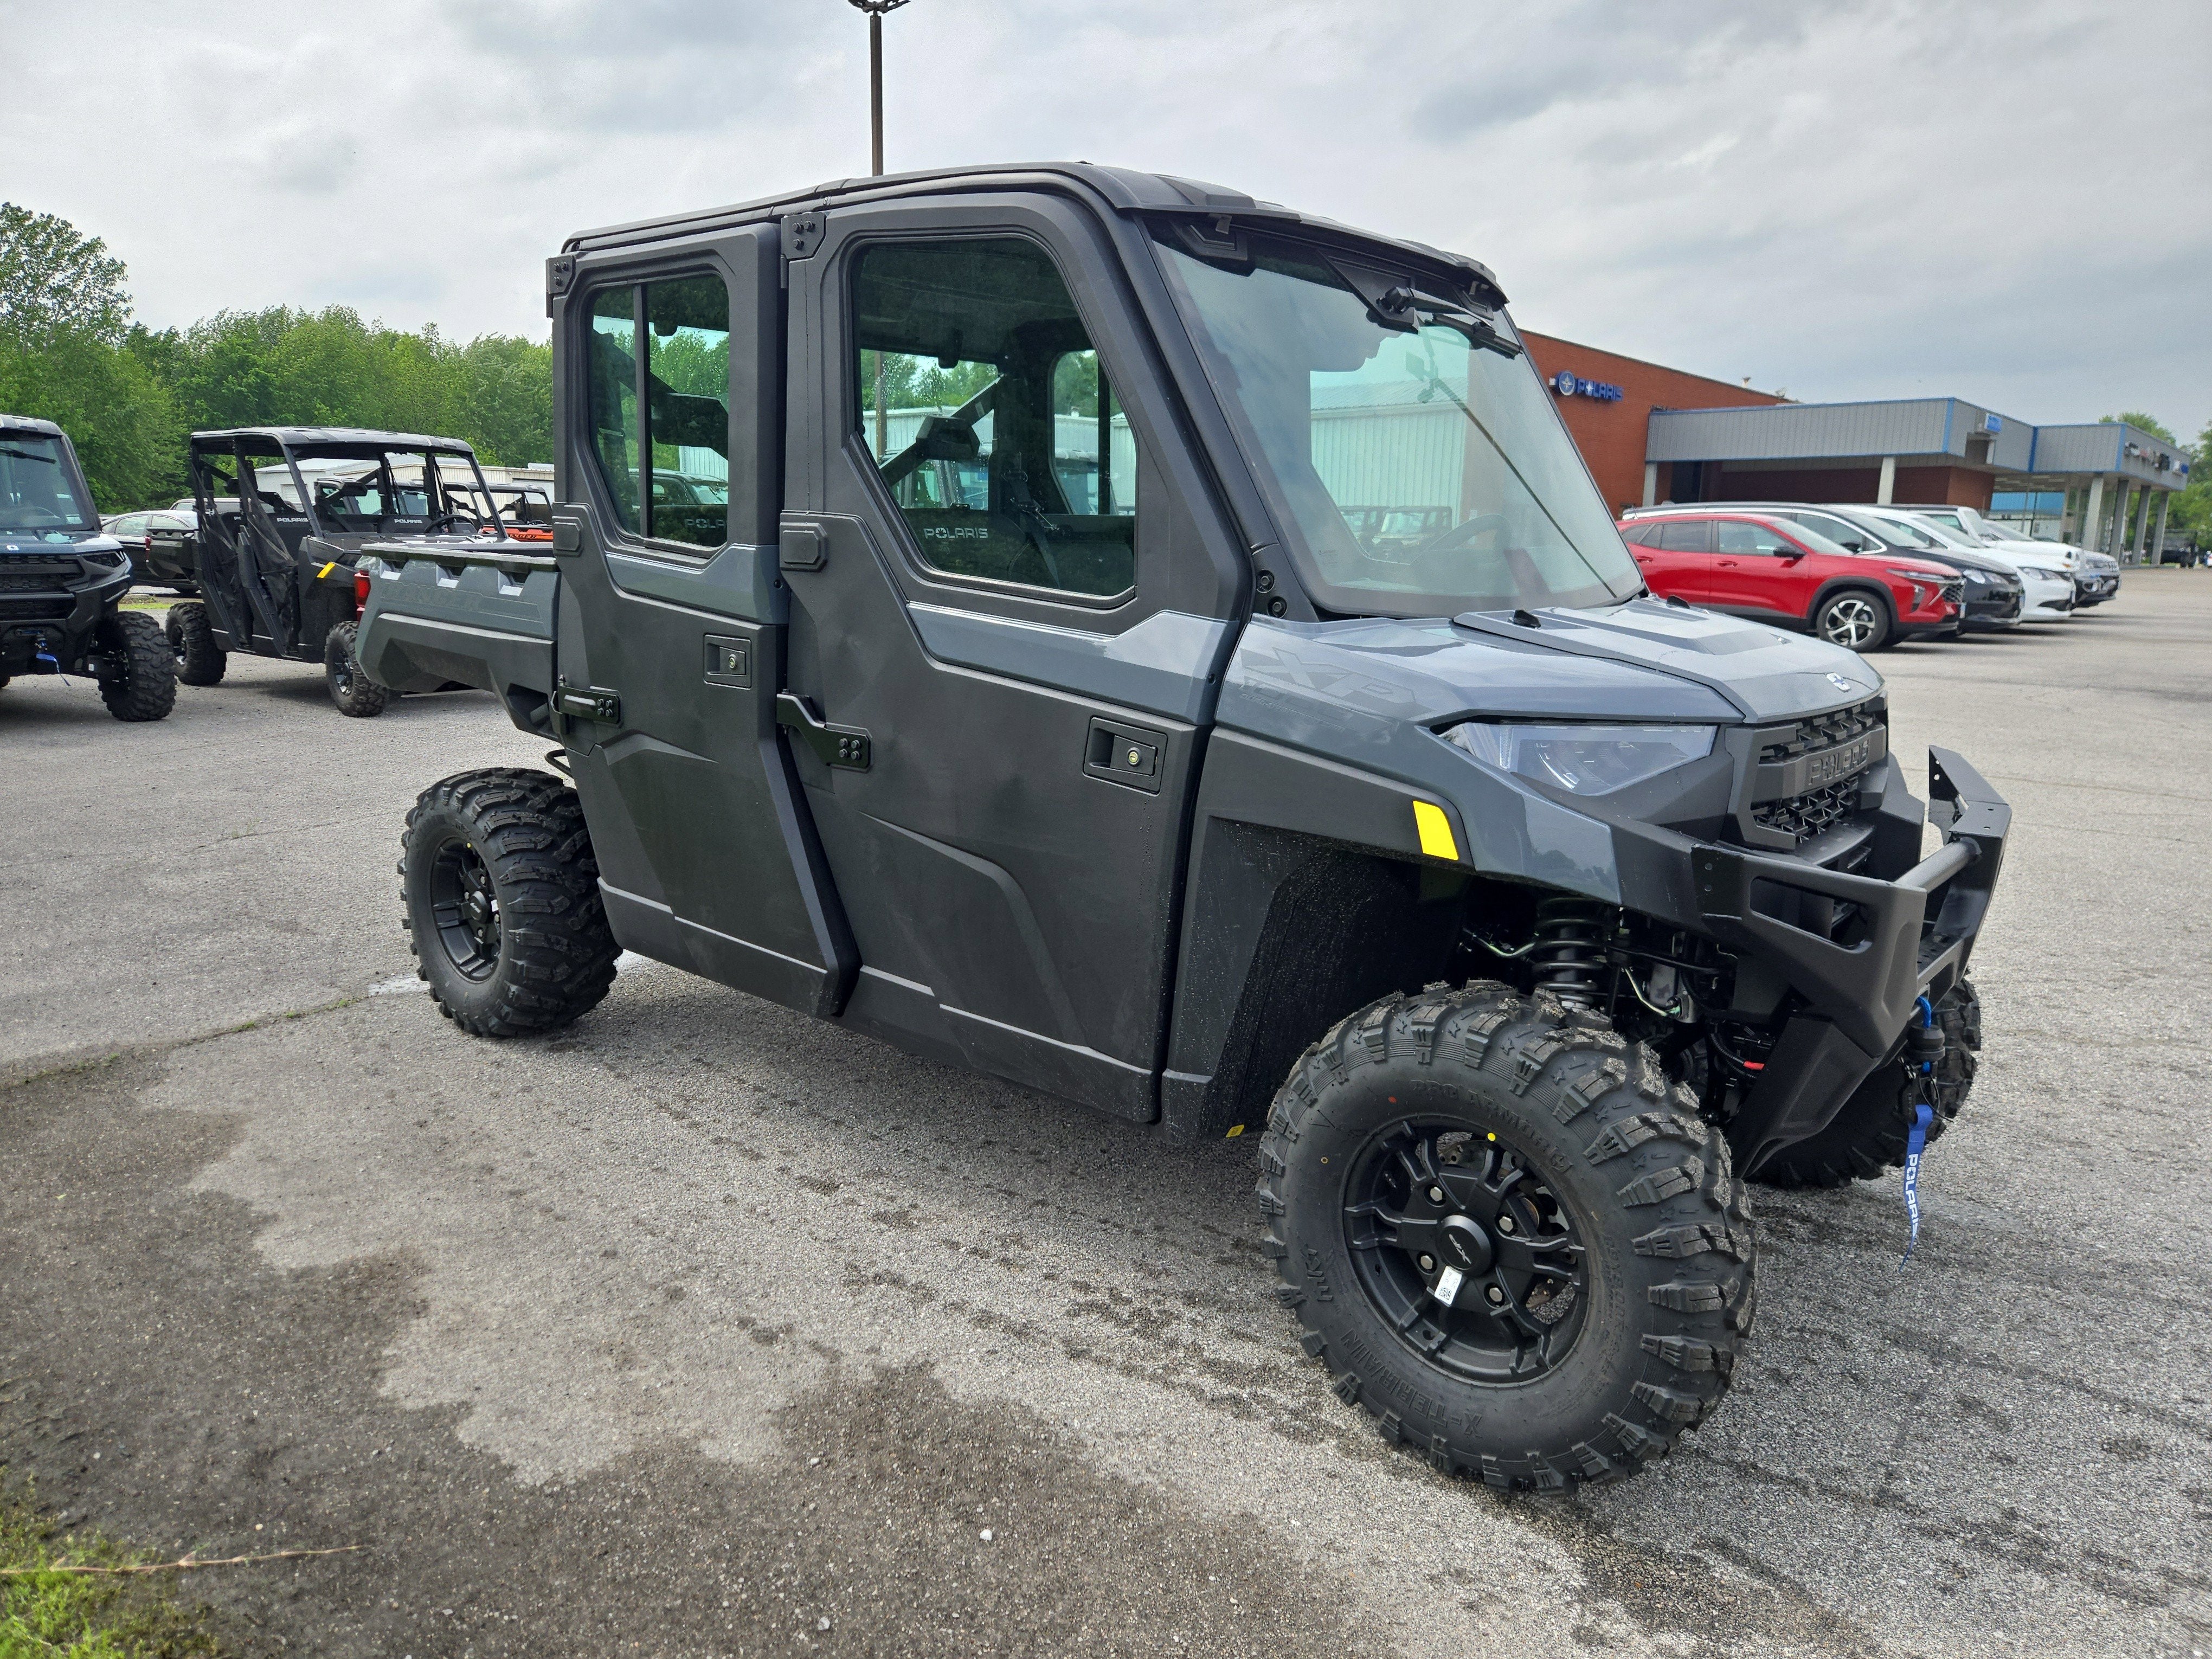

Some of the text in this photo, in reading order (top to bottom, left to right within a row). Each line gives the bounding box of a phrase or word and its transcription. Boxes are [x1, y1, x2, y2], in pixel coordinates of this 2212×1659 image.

[1577, 378, 1624, 402] POLARIS
[923, 528, 988, 539] POLARIS
[1808, 739, 1869, 786] POLARIS
[1340, 1328, 1482, 1438] X-TERRAIN
